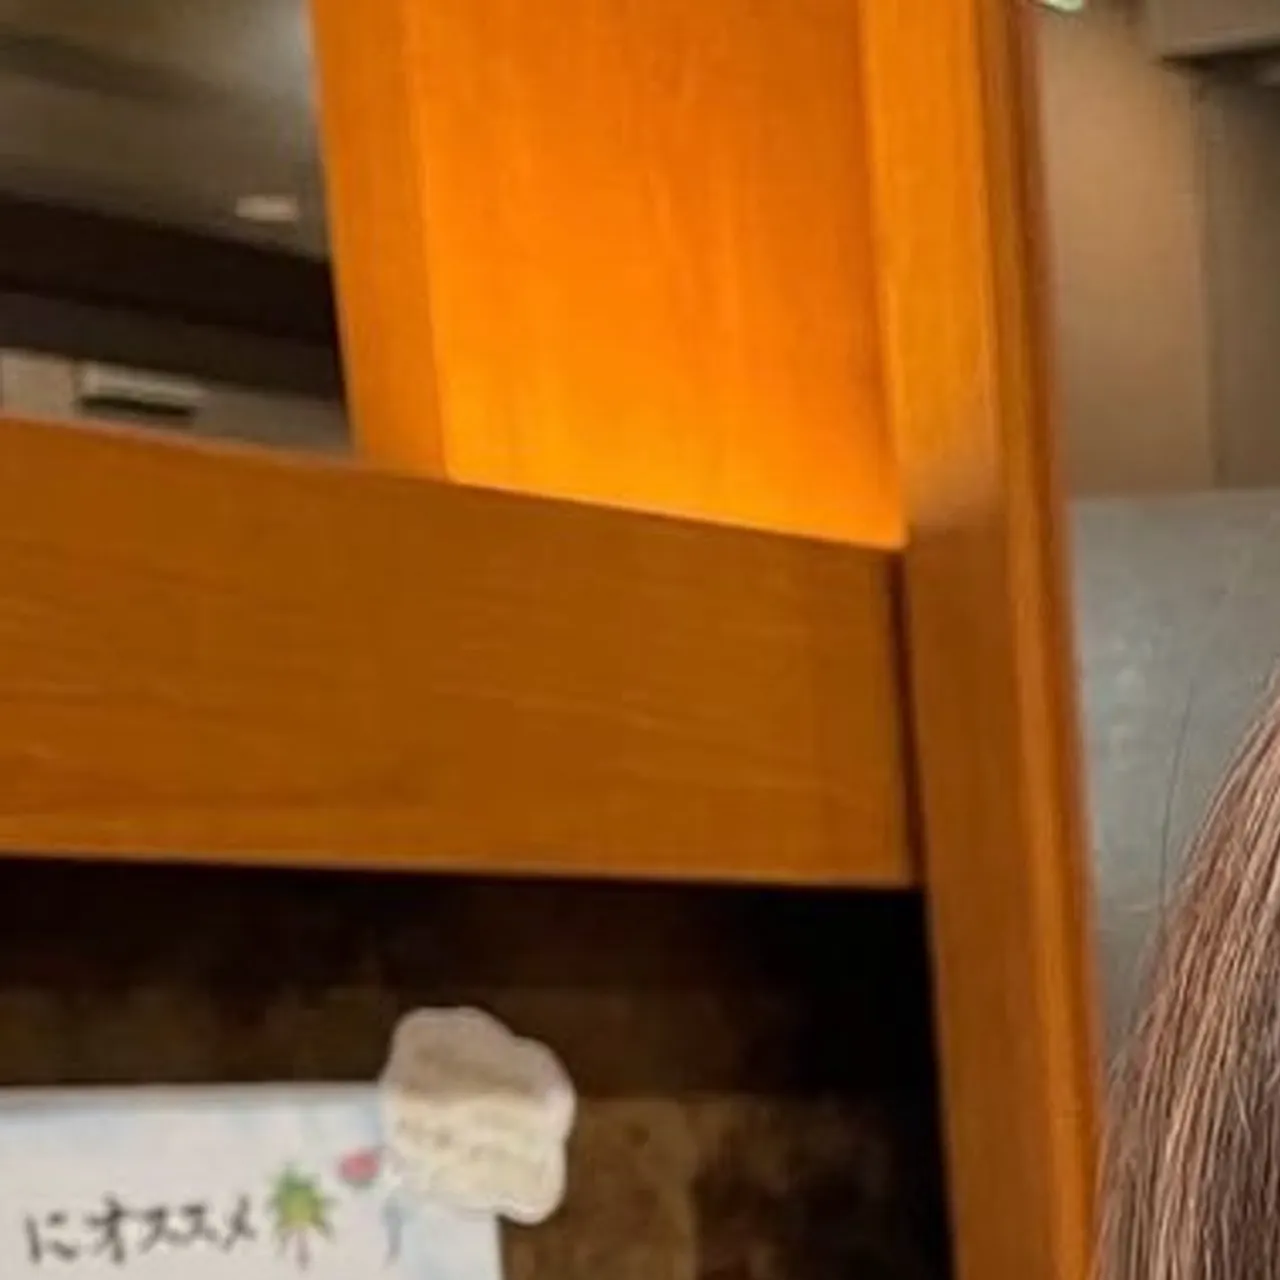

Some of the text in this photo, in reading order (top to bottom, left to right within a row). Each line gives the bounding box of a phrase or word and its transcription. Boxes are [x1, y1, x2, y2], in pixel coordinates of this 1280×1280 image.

[25, 1192, 256, 1265] にオススメ
